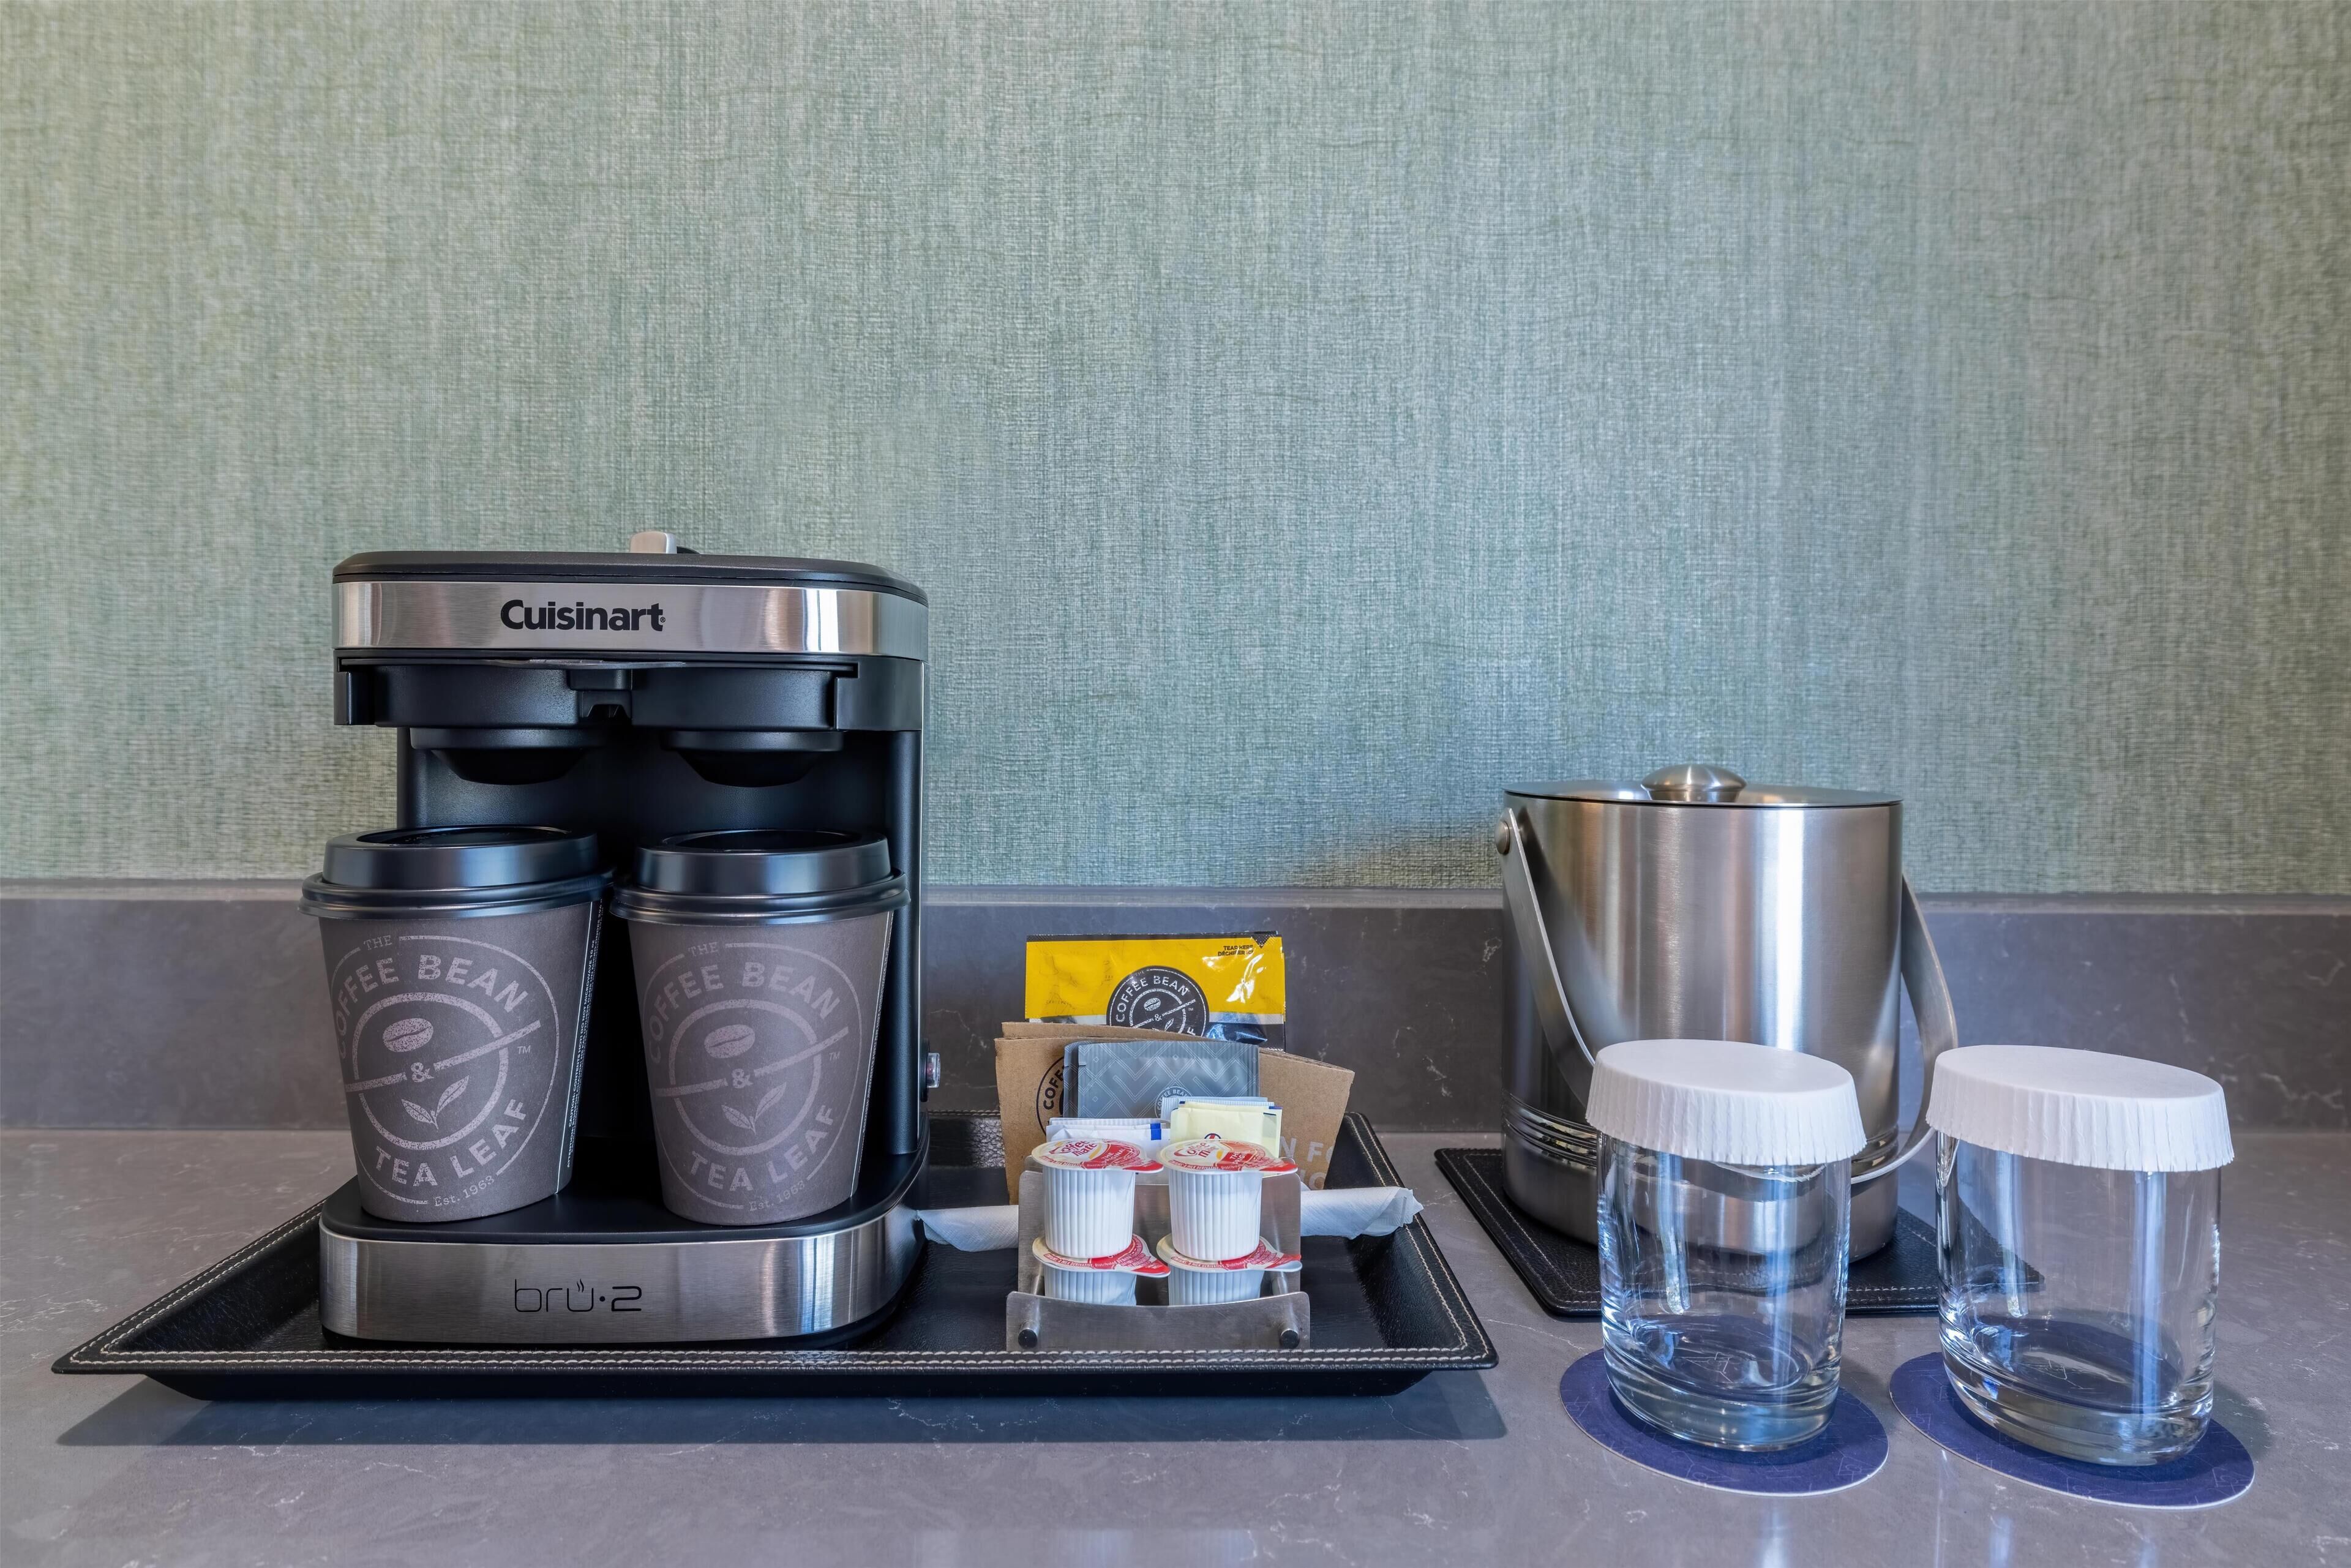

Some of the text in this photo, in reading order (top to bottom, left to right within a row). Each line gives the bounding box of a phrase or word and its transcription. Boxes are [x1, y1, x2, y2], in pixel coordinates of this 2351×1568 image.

[364, 935, 392, 951] THE
[688, 941, 719, 956] THE
[337, 958, 399, 1059] COFFEE
[418, 955, 528, 1013] BEAN
[649, 964, 724, 1063] COFFEE
[742, 962, 841, 1020] BEAN
[1116, 975, 1190, 1022] COFFEE BEAN
[411, 1062, 434, 1082] &
[732, 1068, 754, 1089] &
[375, 1146, 438, 1187] TEA
[450, 1098, 528, 1179] LEAF
[691, 1150, 754, 1192] TEA
[767, 1105, 834, 1184] LEAF
[433, 1176, 495, 1207] Est. 1963
[749, 1180, 806, 1212] Est. 1963
